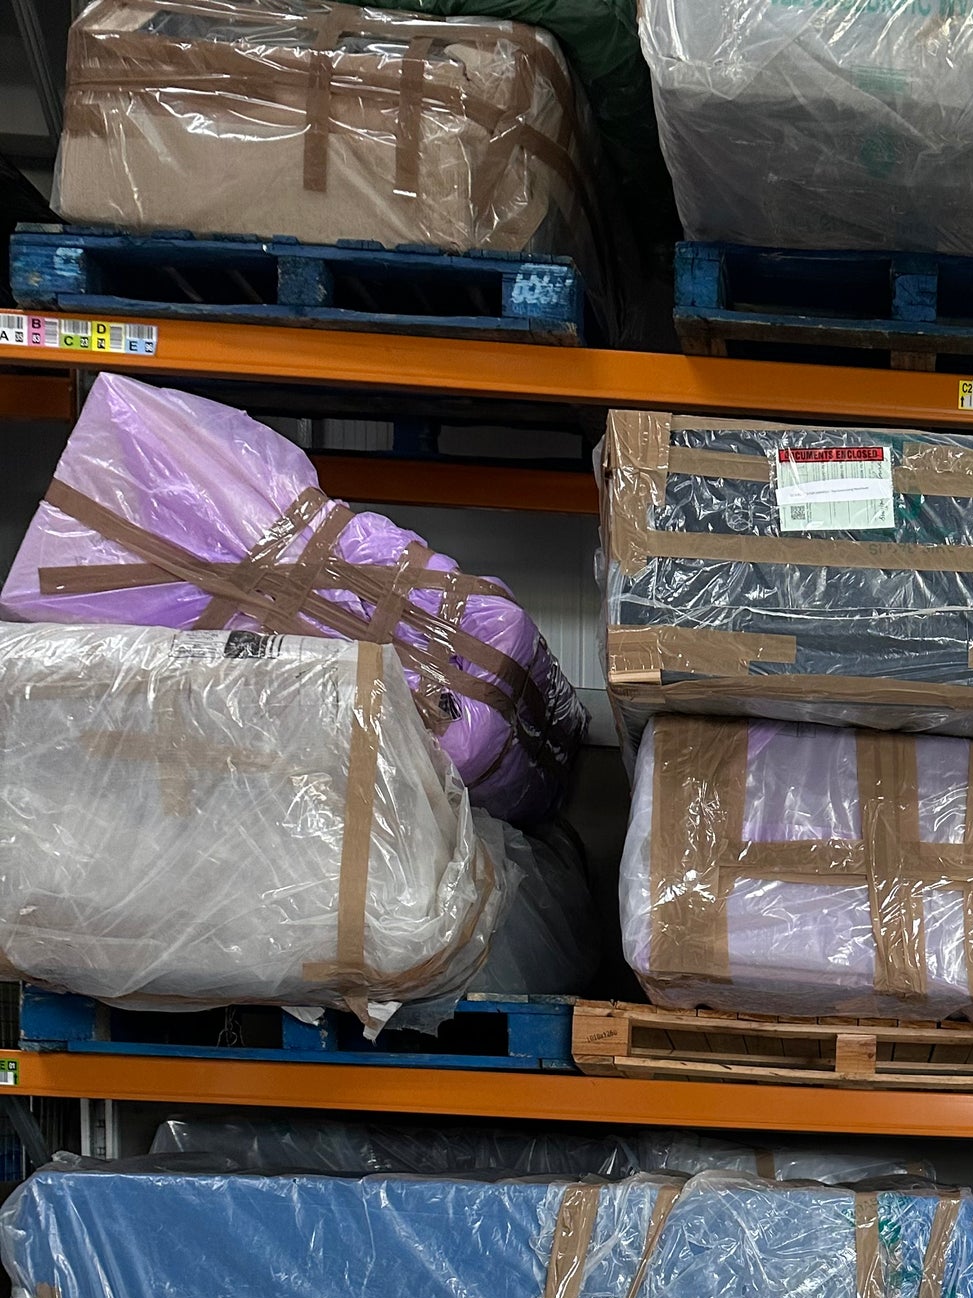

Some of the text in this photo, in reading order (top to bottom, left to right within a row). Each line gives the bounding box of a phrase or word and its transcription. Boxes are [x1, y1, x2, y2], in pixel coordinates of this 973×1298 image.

[31, 318, 41, 329] B
[97, 324, 106, 334] D
[0, 331, 9, 341] A
[63, 336, 74, 346] C
[129, 341, 138, 351] E
[836, 449, 878, 460] ENCLOSED
